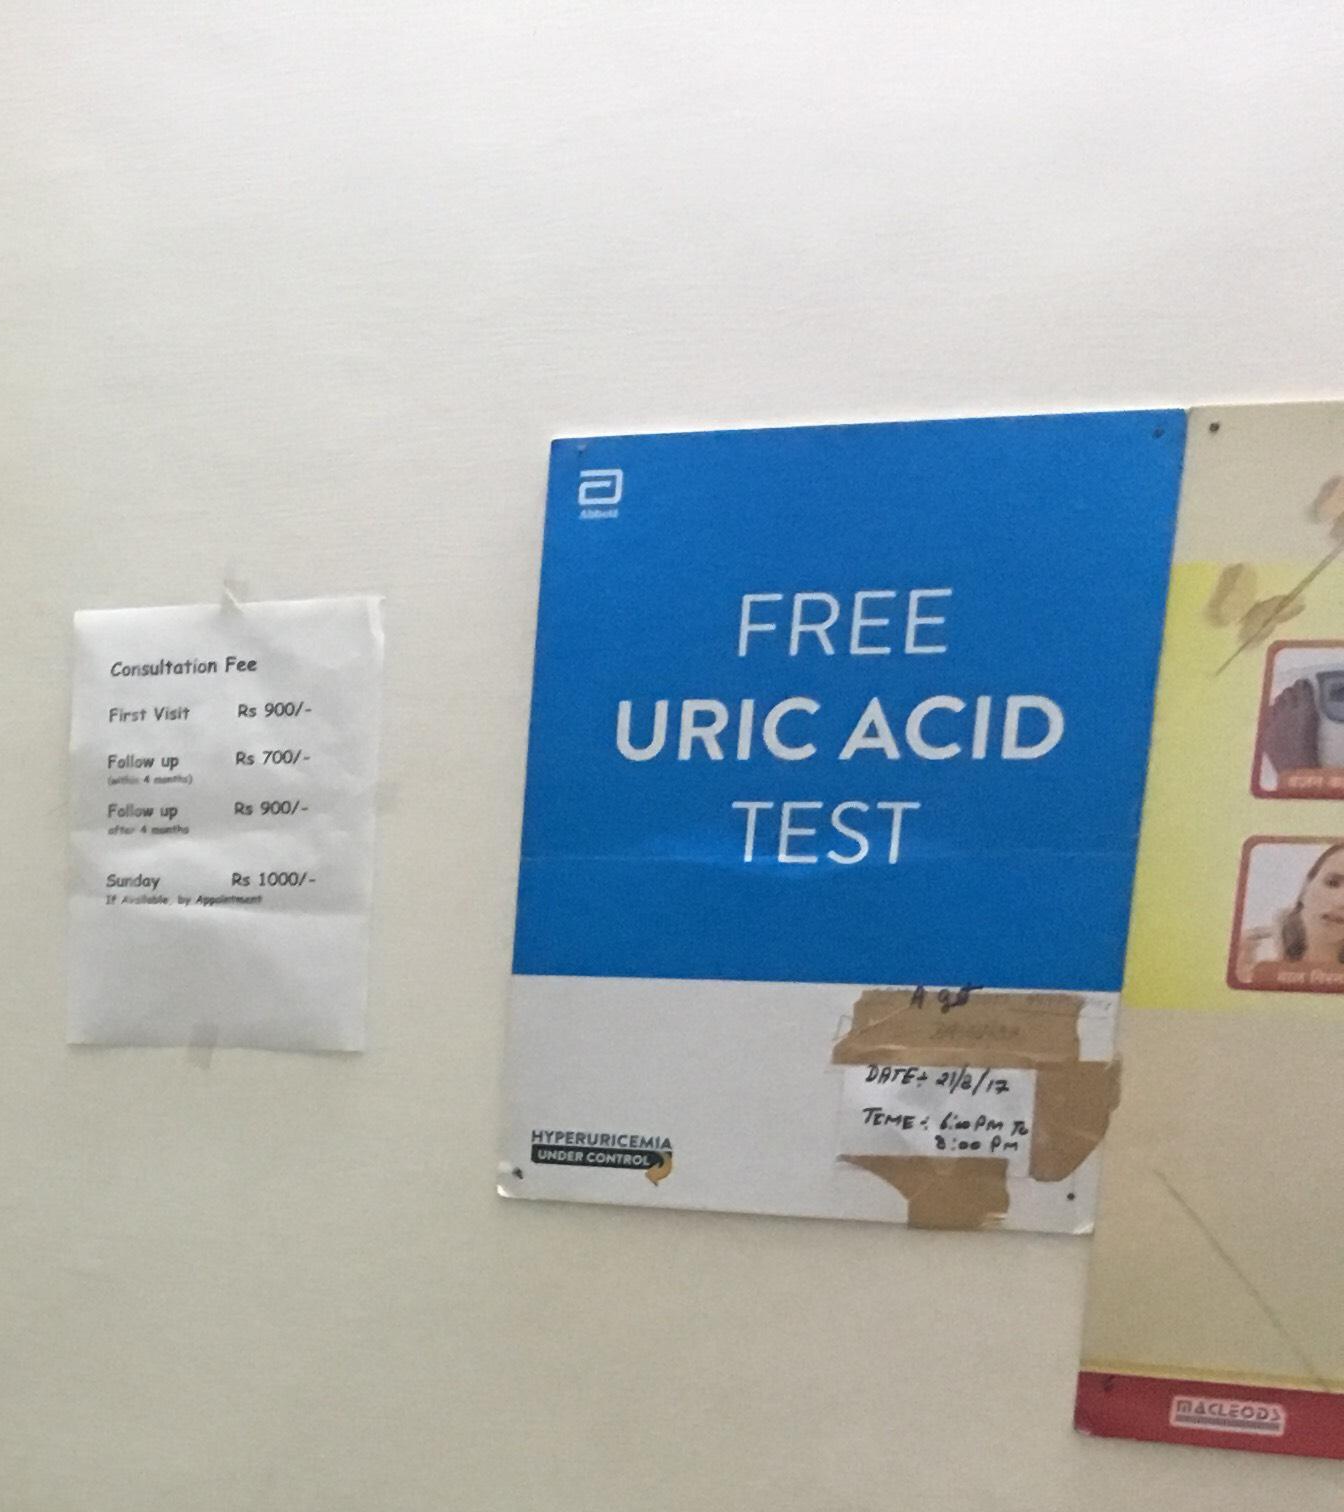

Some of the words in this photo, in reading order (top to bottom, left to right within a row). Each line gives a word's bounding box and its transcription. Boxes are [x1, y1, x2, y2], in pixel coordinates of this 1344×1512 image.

[737, 588, 953, 656] FREE
[110, 658, 217, 677] Consultation
[225, 656, 258, 673] Fee
[109, 707, 147, 723] First
[154, 706, 191, 721] Visit
[237, 703, 257, 718] Rs
[264, 701, 312, 718] 900/-
[615, 697, 818, 761] URIC
[838, 695, 1065, 760] ACID
[107, 754, 154, 769] Follow
[161, 756, 179, 771] up
[235, 751, 255, 765] Rs
[262, 749, 311, 765] 700/-
[143, 775, 150, 784] 4
[107, 803, 154, 818] Follow
[160, 805, 178, 820] up
[234, 801, 253, 815] Rs
[260, 800, 309, 815] 900/-
[140, 825, 147, 834] 4
[732, 800, 920, 864] TEST
[106, 873, 160, 890] Sunday
[231, 872, 250, 887] Rs
[258, 871, 316, 887] 1000/-
[178, 894, 191, 907] by
[195, 894, 263, 906] Appointment
[531, 1130, 673, 1150] HYPERURICEMIA
[538, 1149, 584, 1162] UNDER
[586, 1152, 650, 1166] CONTROL
[1176, 1400, 1281, 1421] MACLEODS
